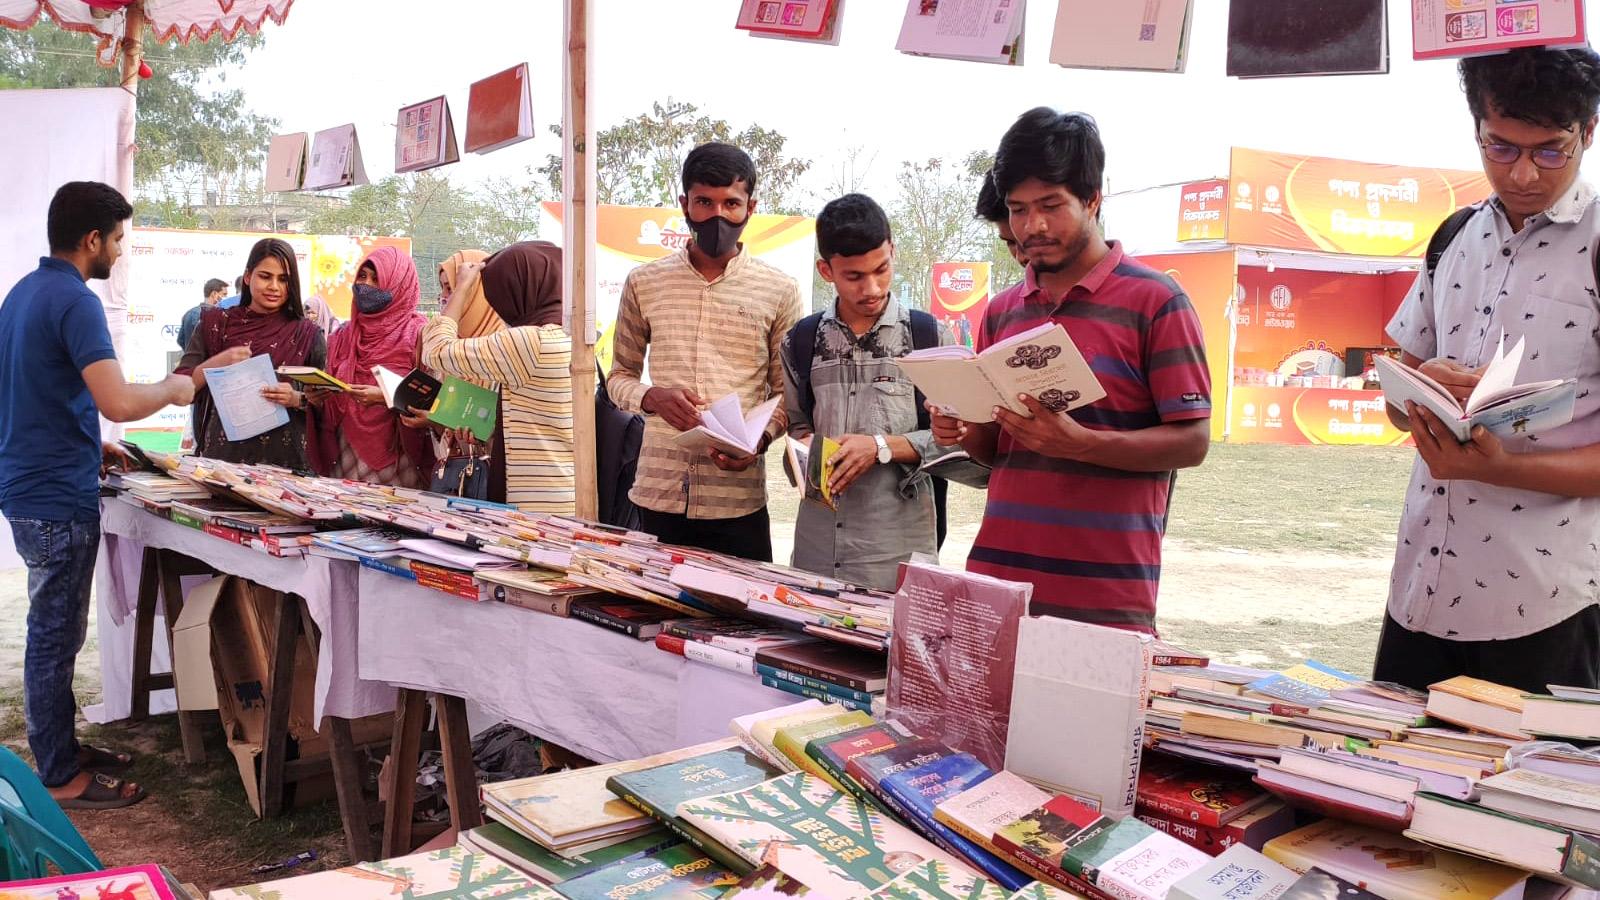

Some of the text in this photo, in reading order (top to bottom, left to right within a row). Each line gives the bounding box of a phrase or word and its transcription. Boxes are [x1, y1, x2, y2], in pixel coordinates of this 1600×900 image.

[1328, 179, 1360, 198] পণ্য
[1328, 399, 1349, 411] পণ্য
[1173, 822, 1198, 839] সমগ্র
